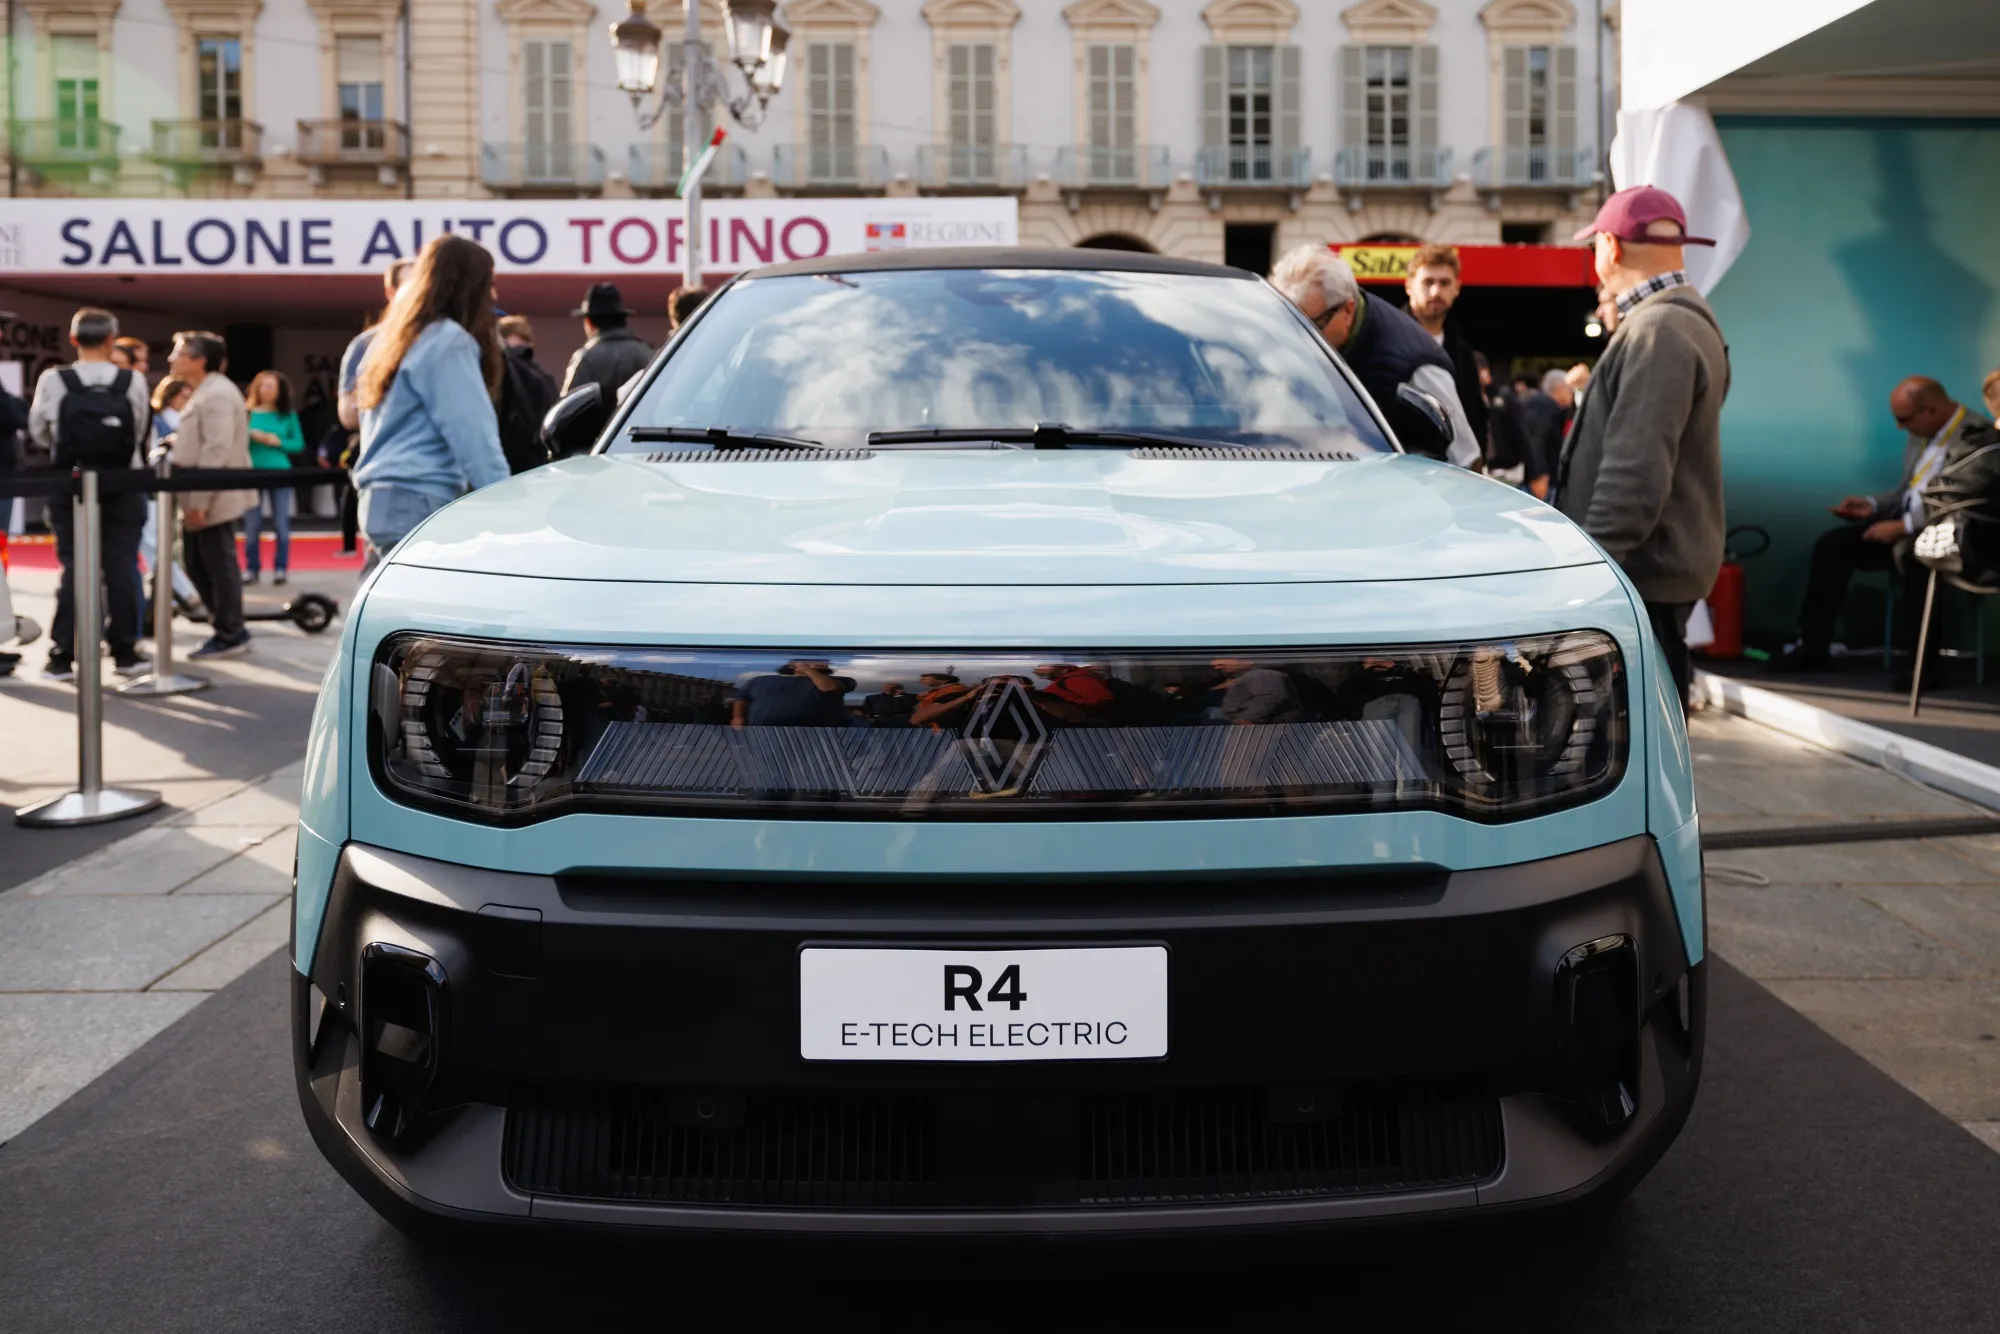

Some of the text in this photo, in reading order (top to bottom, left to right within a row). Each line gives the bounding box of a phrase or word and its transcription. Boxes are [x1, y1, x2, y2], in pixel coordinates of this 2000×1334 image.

[61, 218, 334, 266] SALONE
[911, 222, 1008, 242] REGIONE
[944, 964, 1028, 1012] R4
[842, 1021, 1128, 1047] E-TECH ELECTRIC
